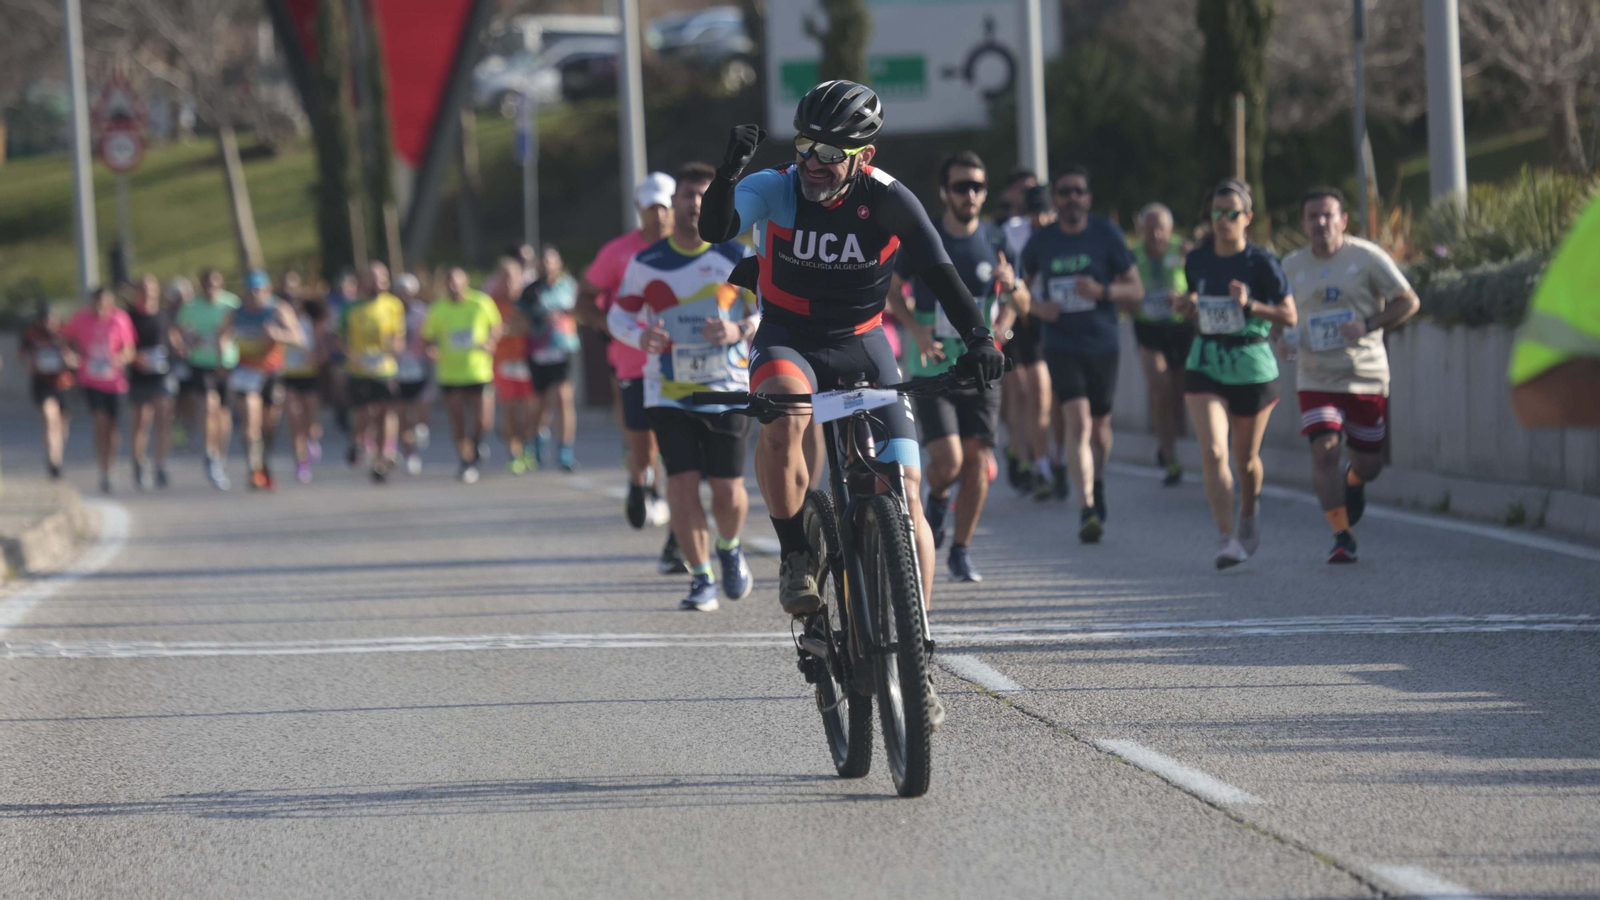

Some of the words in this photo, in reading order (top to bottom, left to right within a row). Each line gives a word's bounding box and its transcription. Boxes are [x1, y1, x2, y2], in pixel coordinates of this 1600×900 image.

[793, 230, 866, 263] UCA
[778, 251, 800, 266] UNIÓN
[801, 260, 833, 270] CICLISTA
[833, 259, 878, 270] ALGECIREÑA
